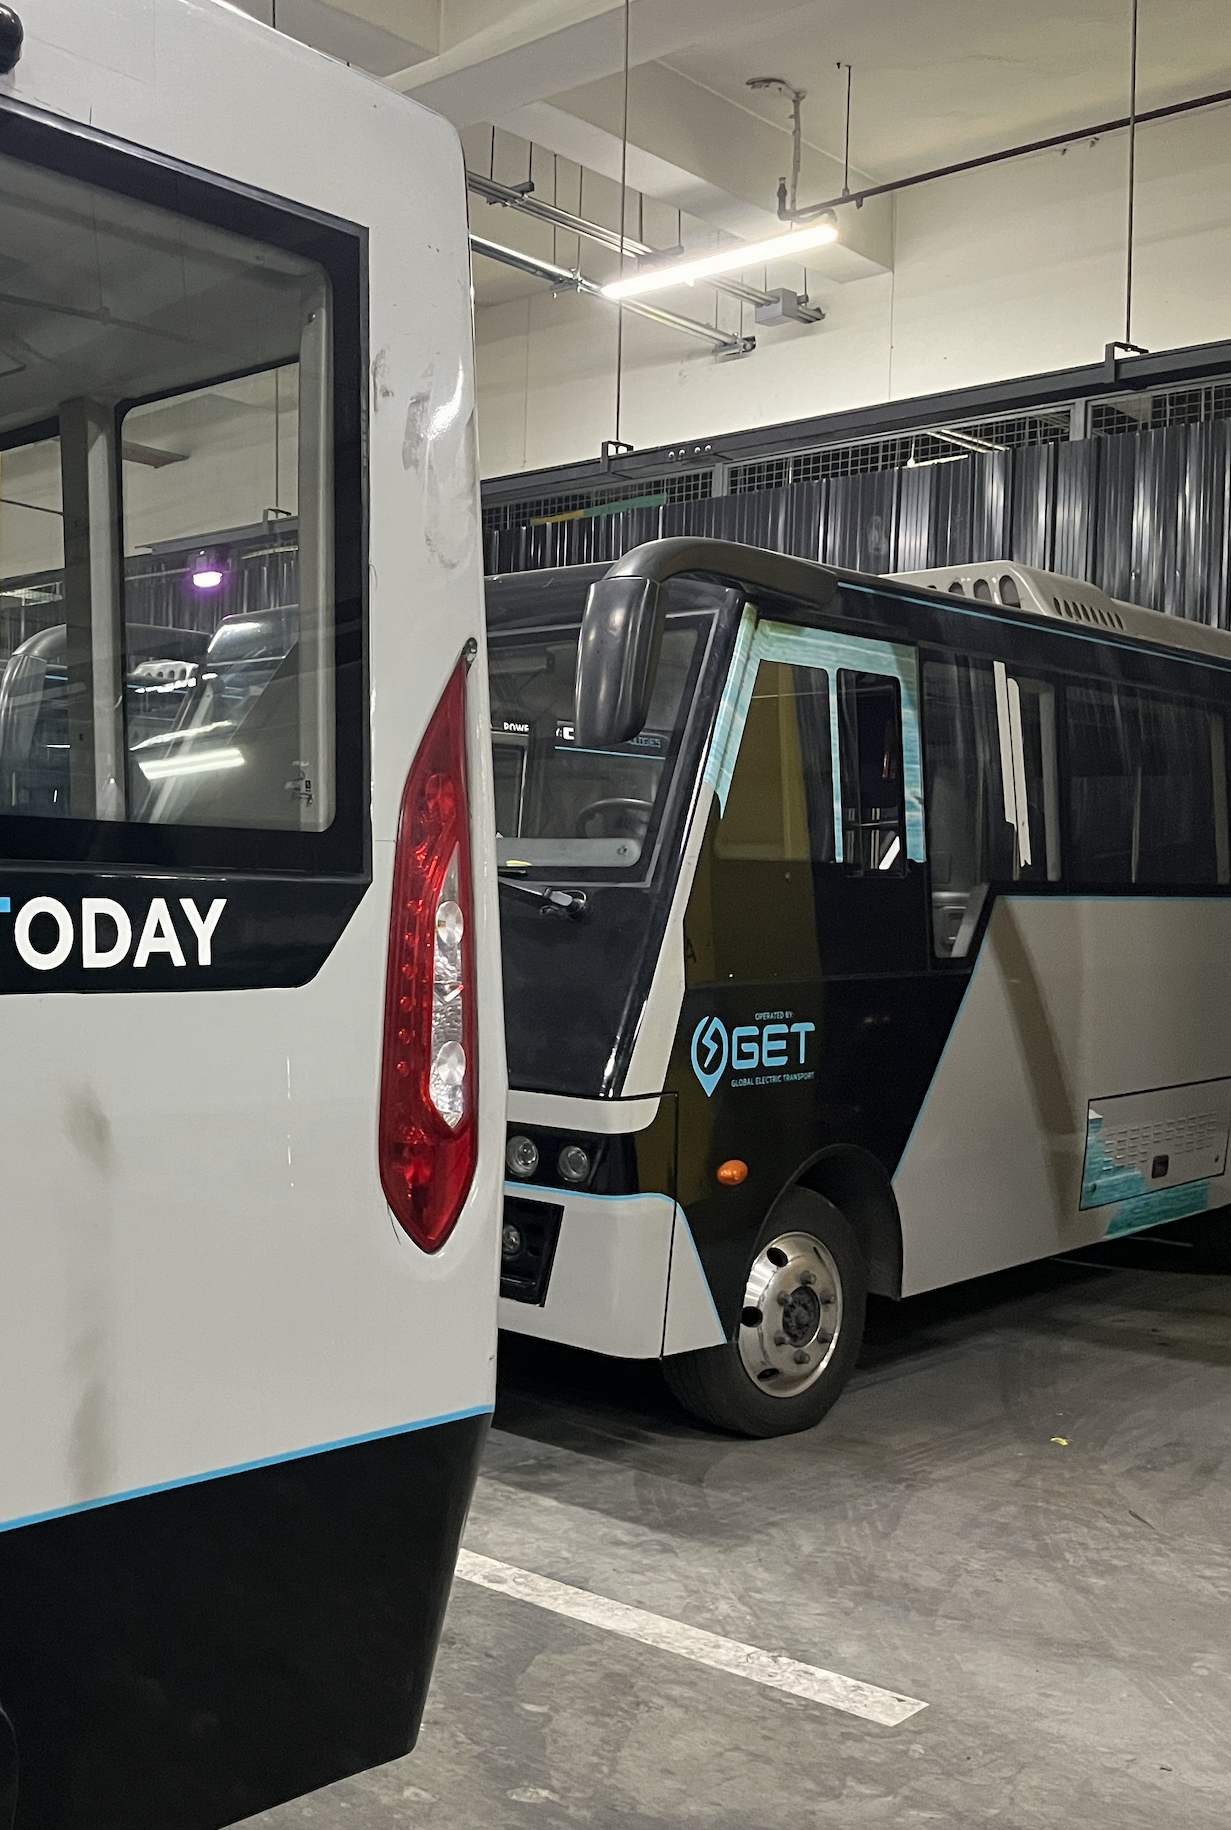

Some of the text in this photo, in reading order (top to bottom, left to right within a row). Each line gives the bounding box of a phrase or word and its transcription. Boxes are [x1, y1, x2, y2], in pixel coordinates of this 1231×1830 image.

[754, 1011, 784, 1020] OPERATED
[732, 1022, 816, 1070] GET
[731, 1071, 815, 1088] GLOBAL ELECTRIC TRANSPORT
